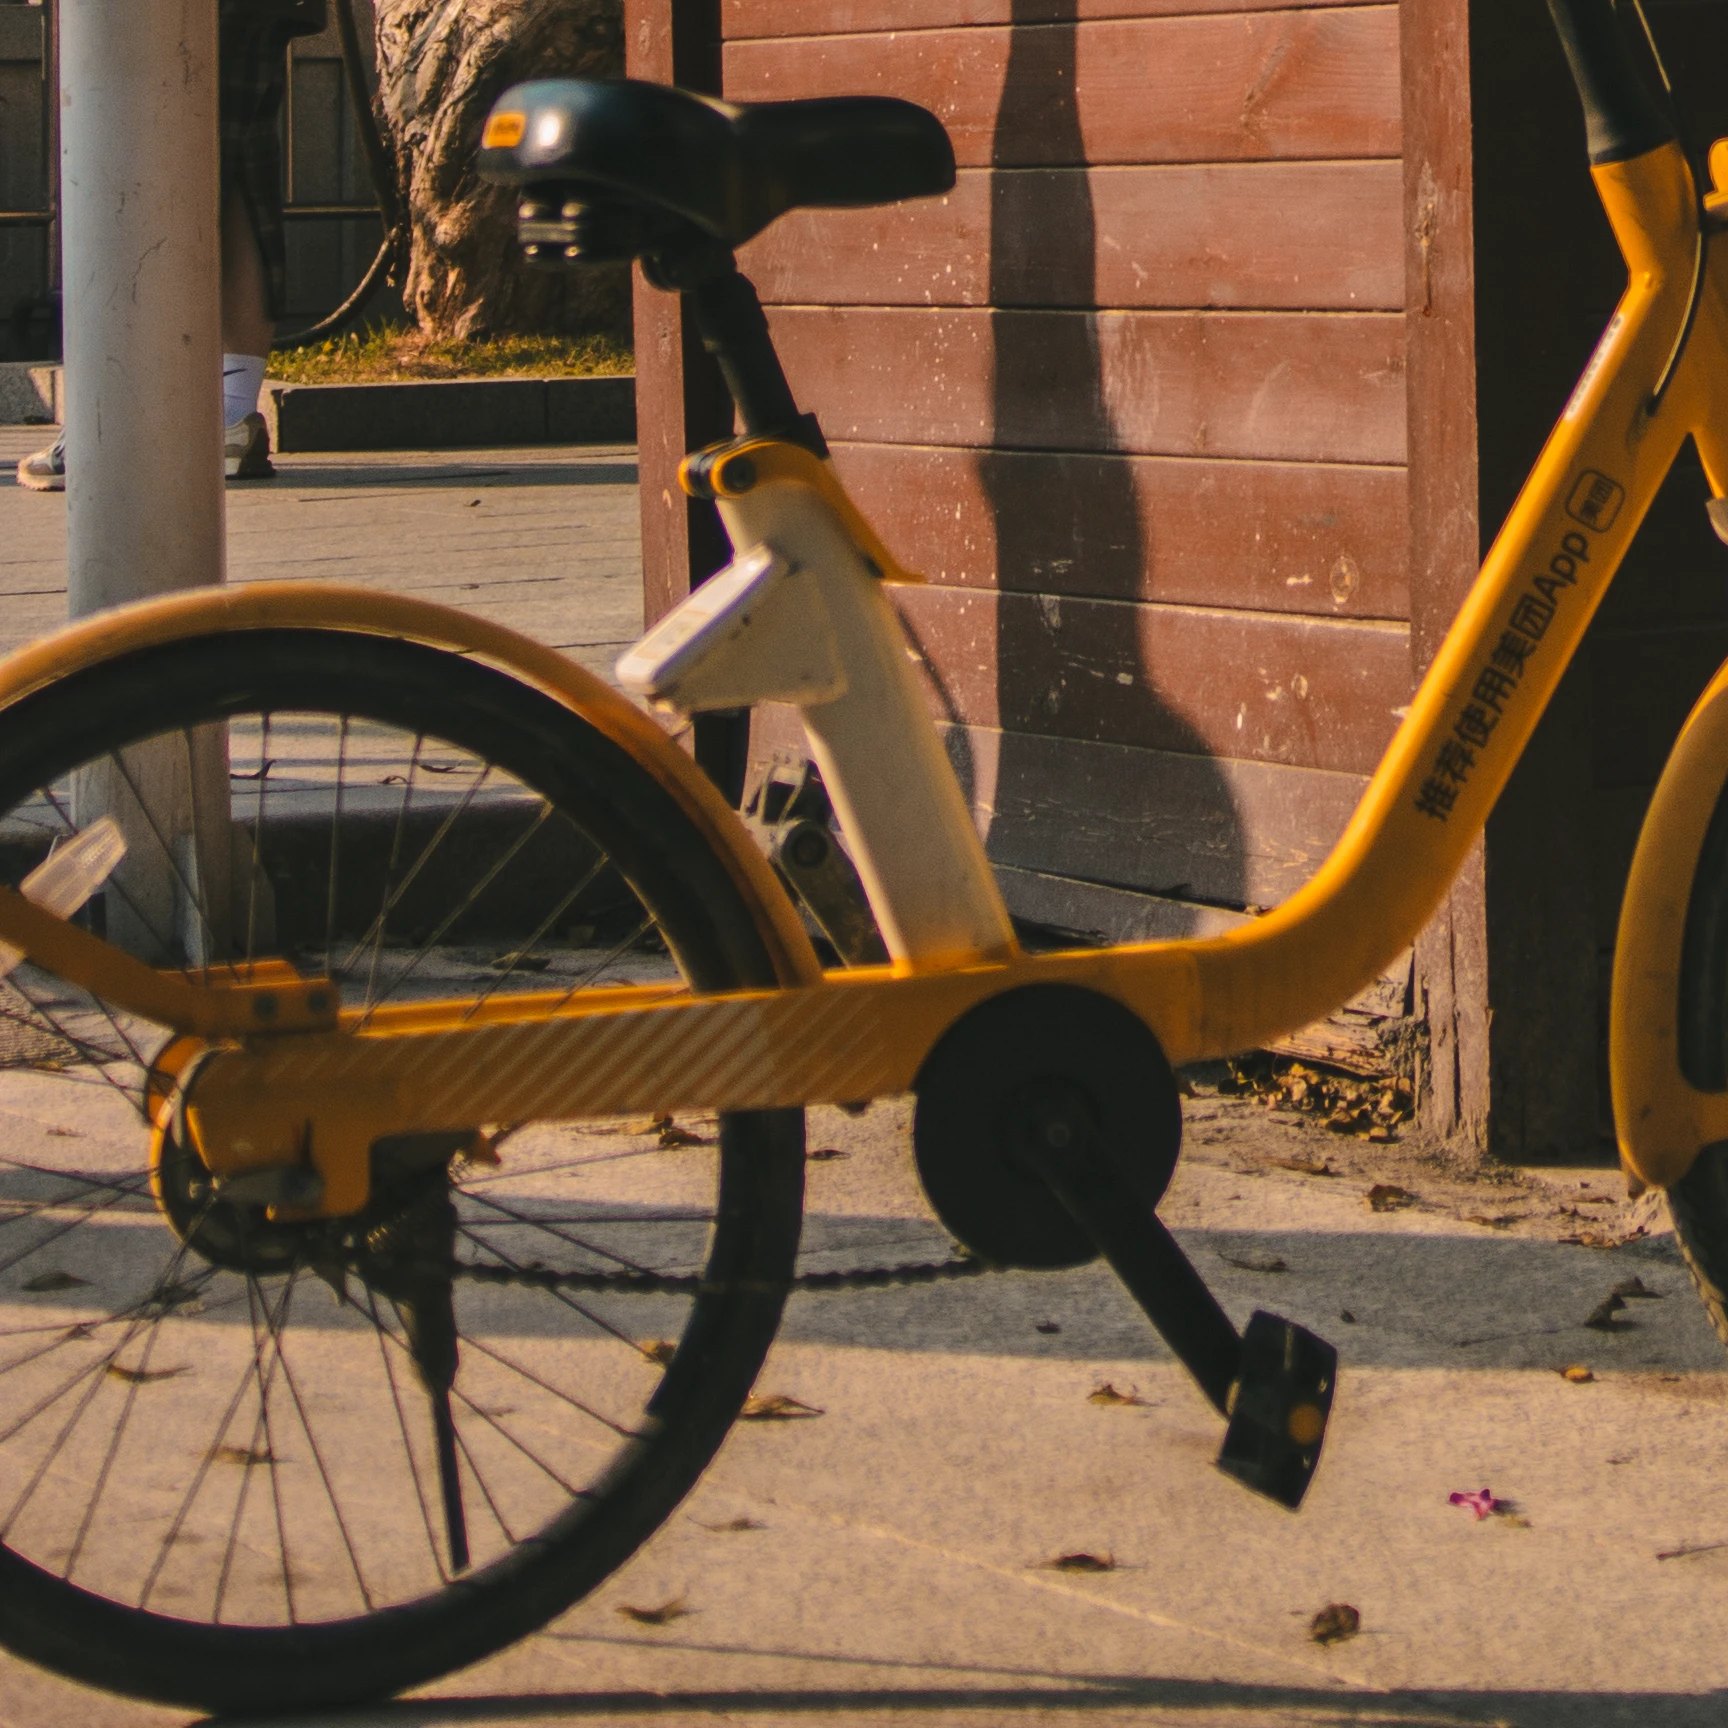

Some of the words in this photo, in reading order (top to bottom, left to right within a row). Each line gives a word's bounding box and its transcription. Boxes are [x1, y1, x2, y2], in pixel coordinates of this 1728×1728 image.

[1414, 531, 1590, 822] 推荐使用美团App
